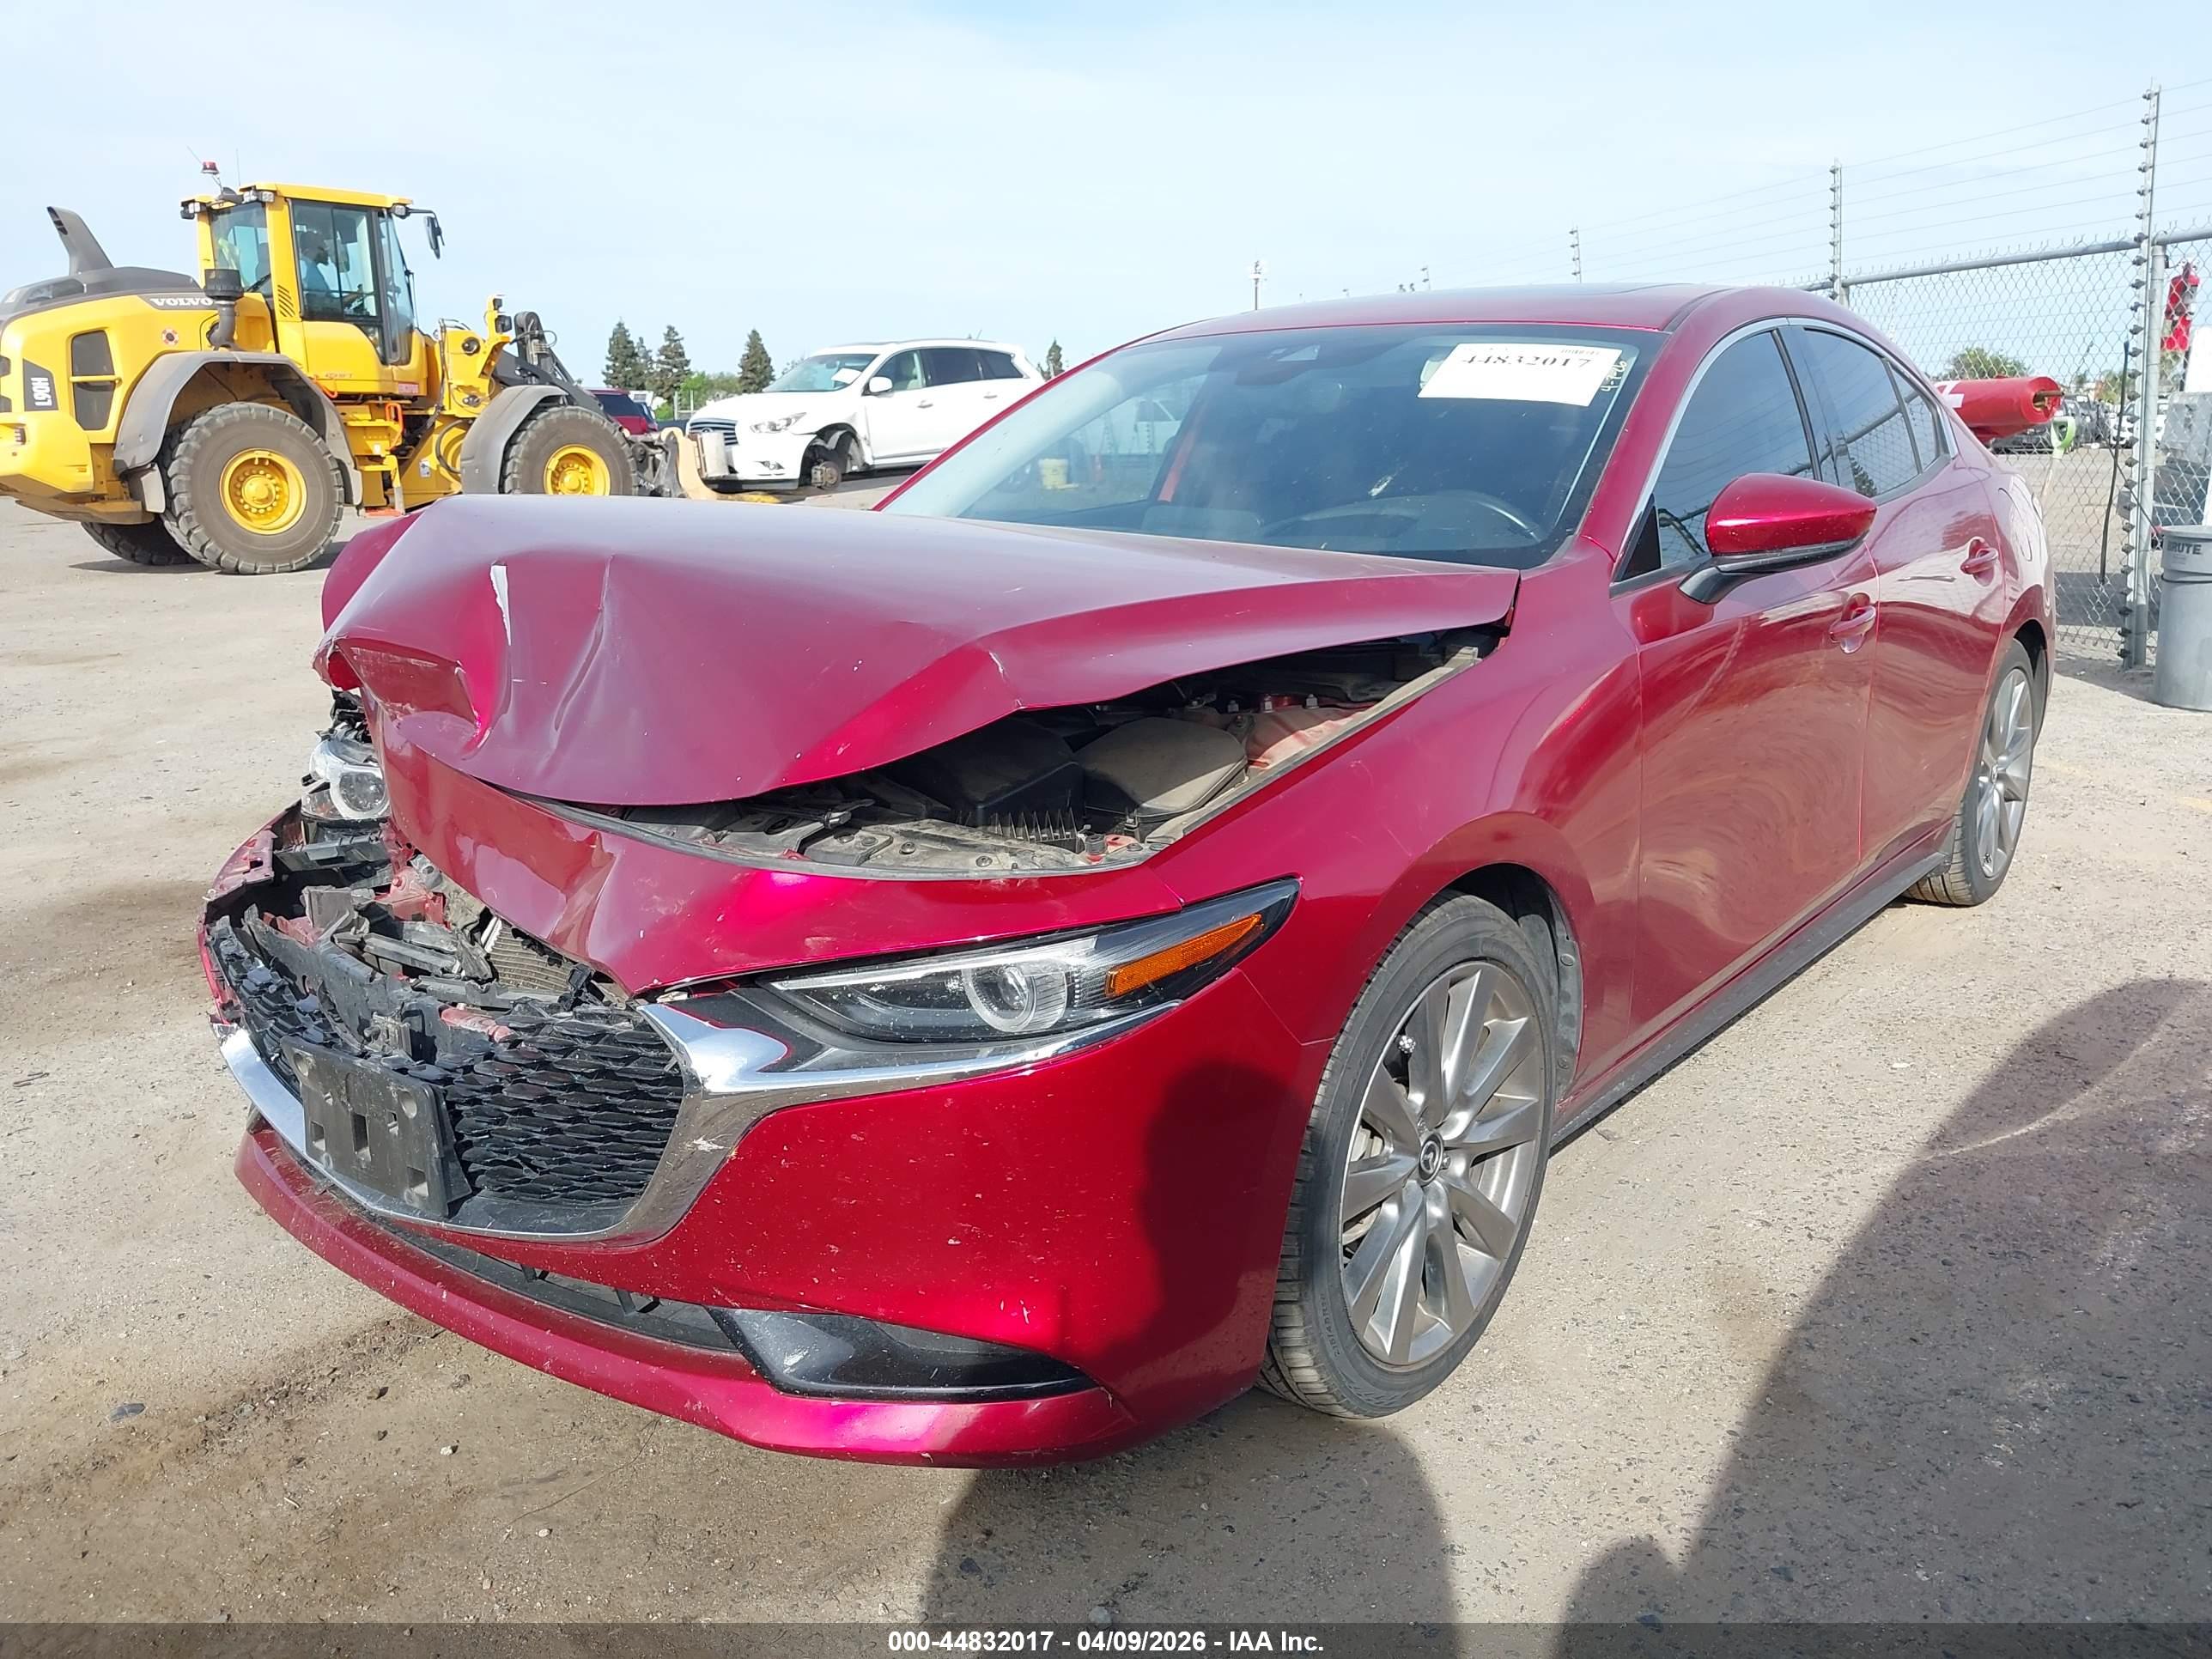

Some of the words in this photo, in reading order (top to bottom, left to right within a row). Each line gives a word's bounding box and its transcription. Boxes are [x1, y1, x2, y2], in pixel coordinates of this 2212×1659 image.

[149, 297, 214, 307] VOLVO
[1462, 355, 1593, 368] 44832017
[30, 377, 52, 406] L90H
[2166, 542, 2203, 556] BRUTE
